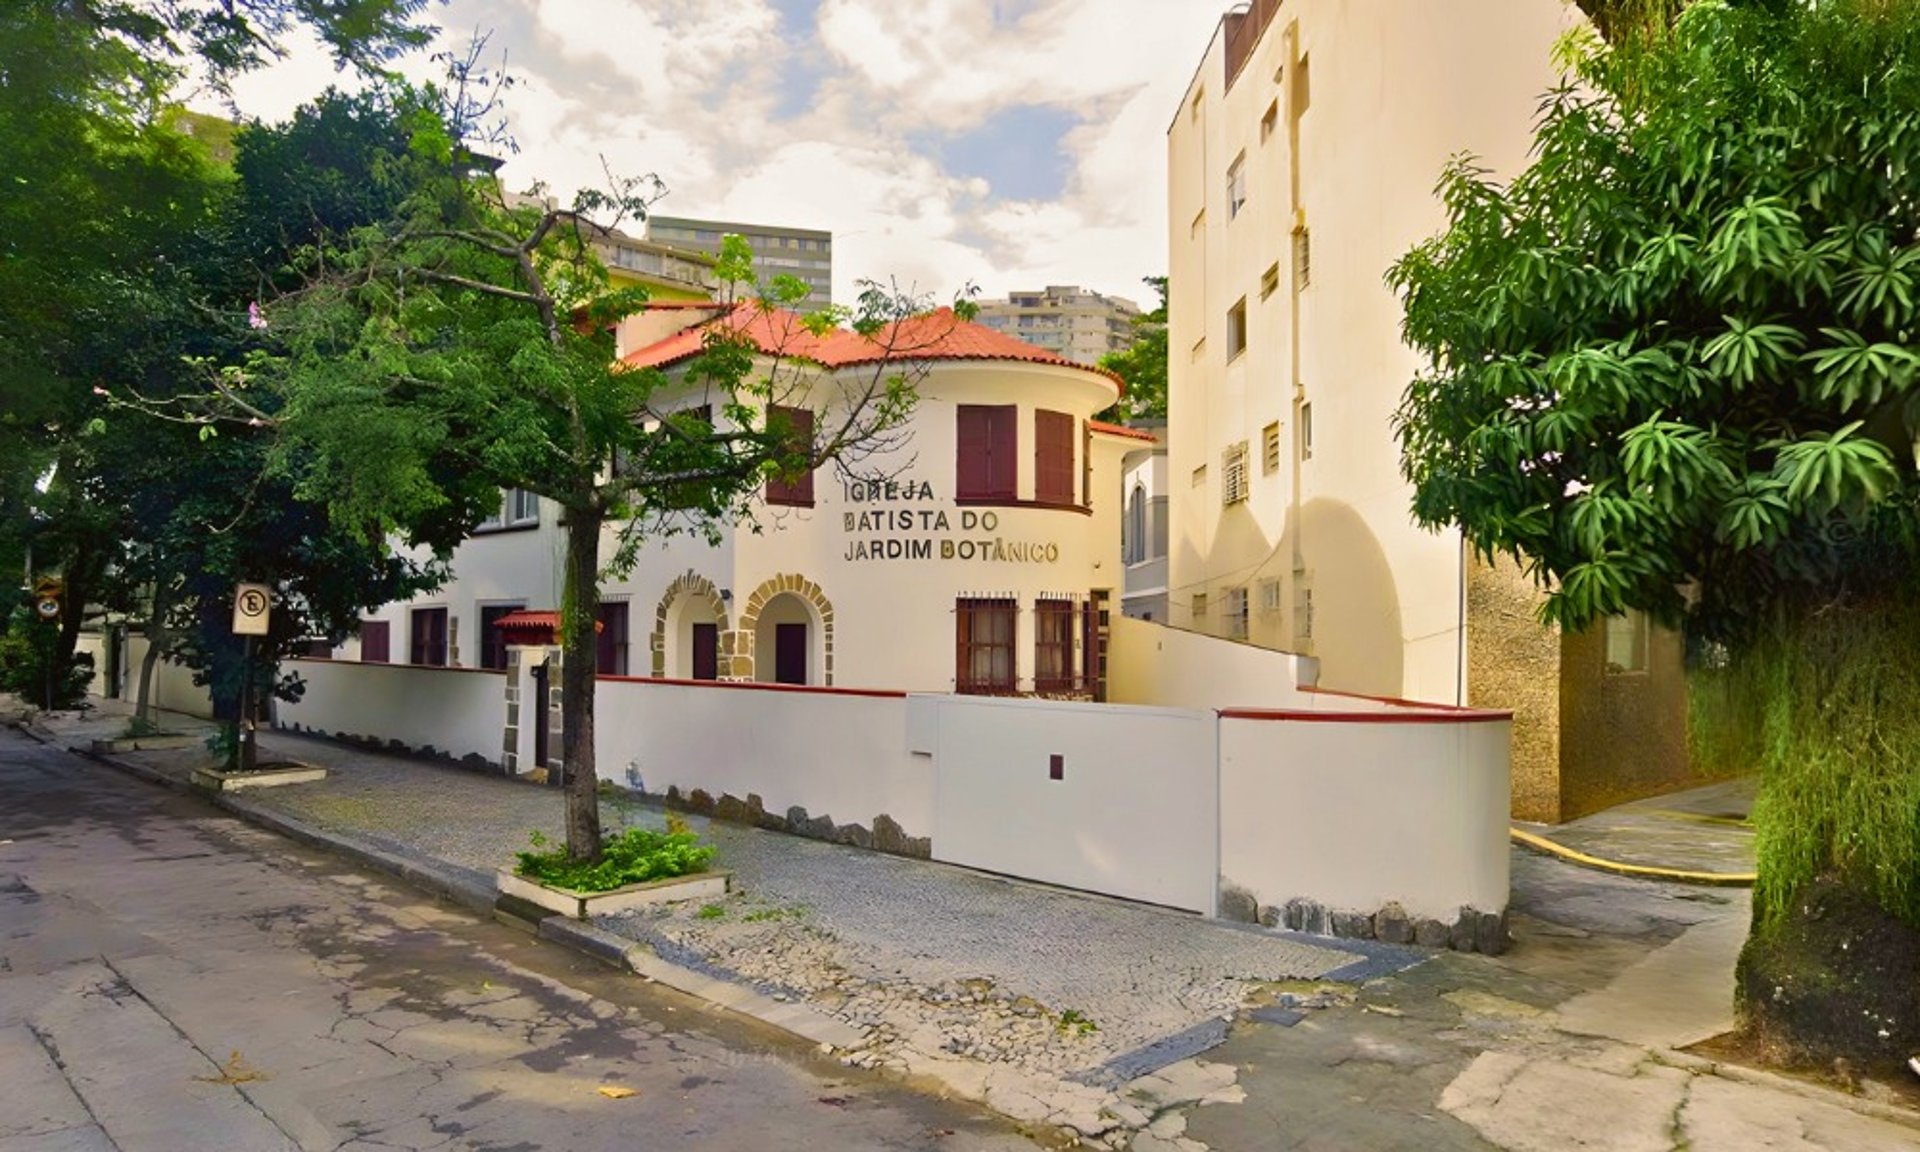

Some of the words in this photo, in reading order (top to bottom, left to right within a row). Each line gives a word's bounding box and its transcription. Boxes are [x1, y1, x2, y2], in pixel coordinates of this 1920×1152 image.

[844, 510, 950, 532] BATISTA
[961, 510, 998, 531] DO
[844, 539, 932, 561] JARDIM
[940, 537, 1059, 563] BOTÂNICO
